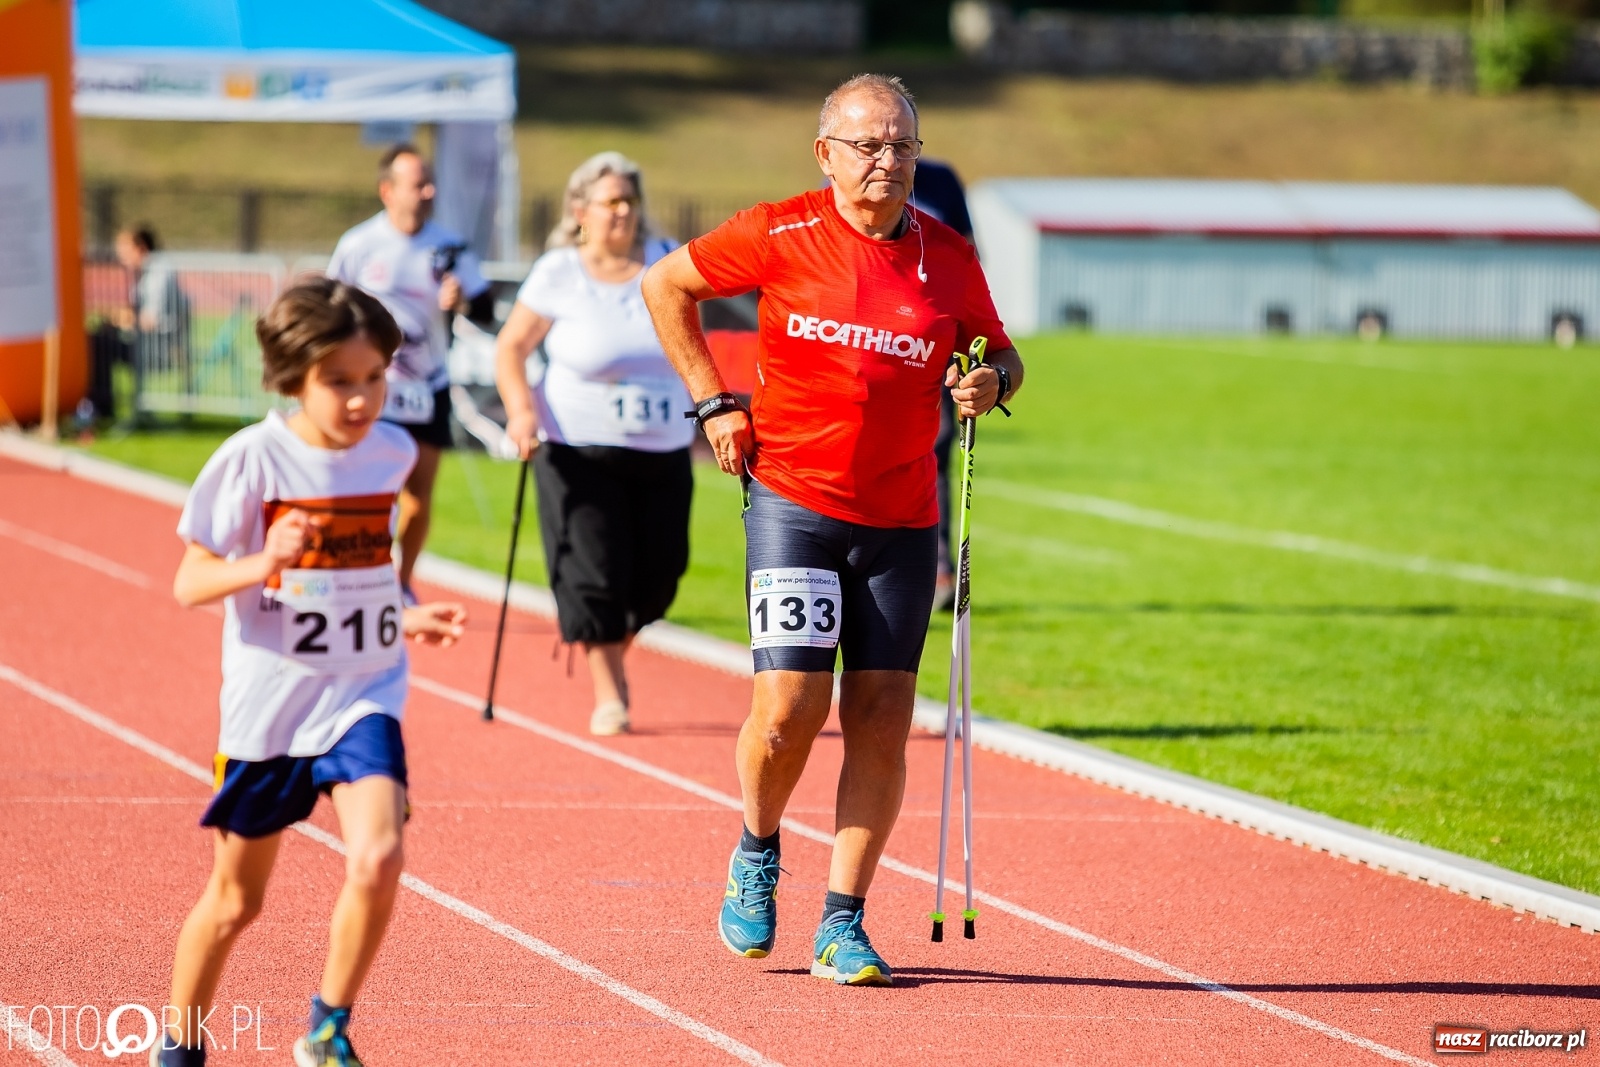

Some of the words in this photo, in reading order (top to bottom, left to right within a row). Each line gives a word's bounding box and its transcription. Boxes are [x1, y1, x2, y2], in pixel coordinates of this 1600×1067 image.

[787, 313, 935, 362] DECATHLON
[904, 360, 926, 369] RYBNIK
[611, 396, 670, 422] 131
[777, 577, 837, 586] www.personalbest.pl
[292, 605, 398, 654] 216
[755, 596, 836, 633] 133
